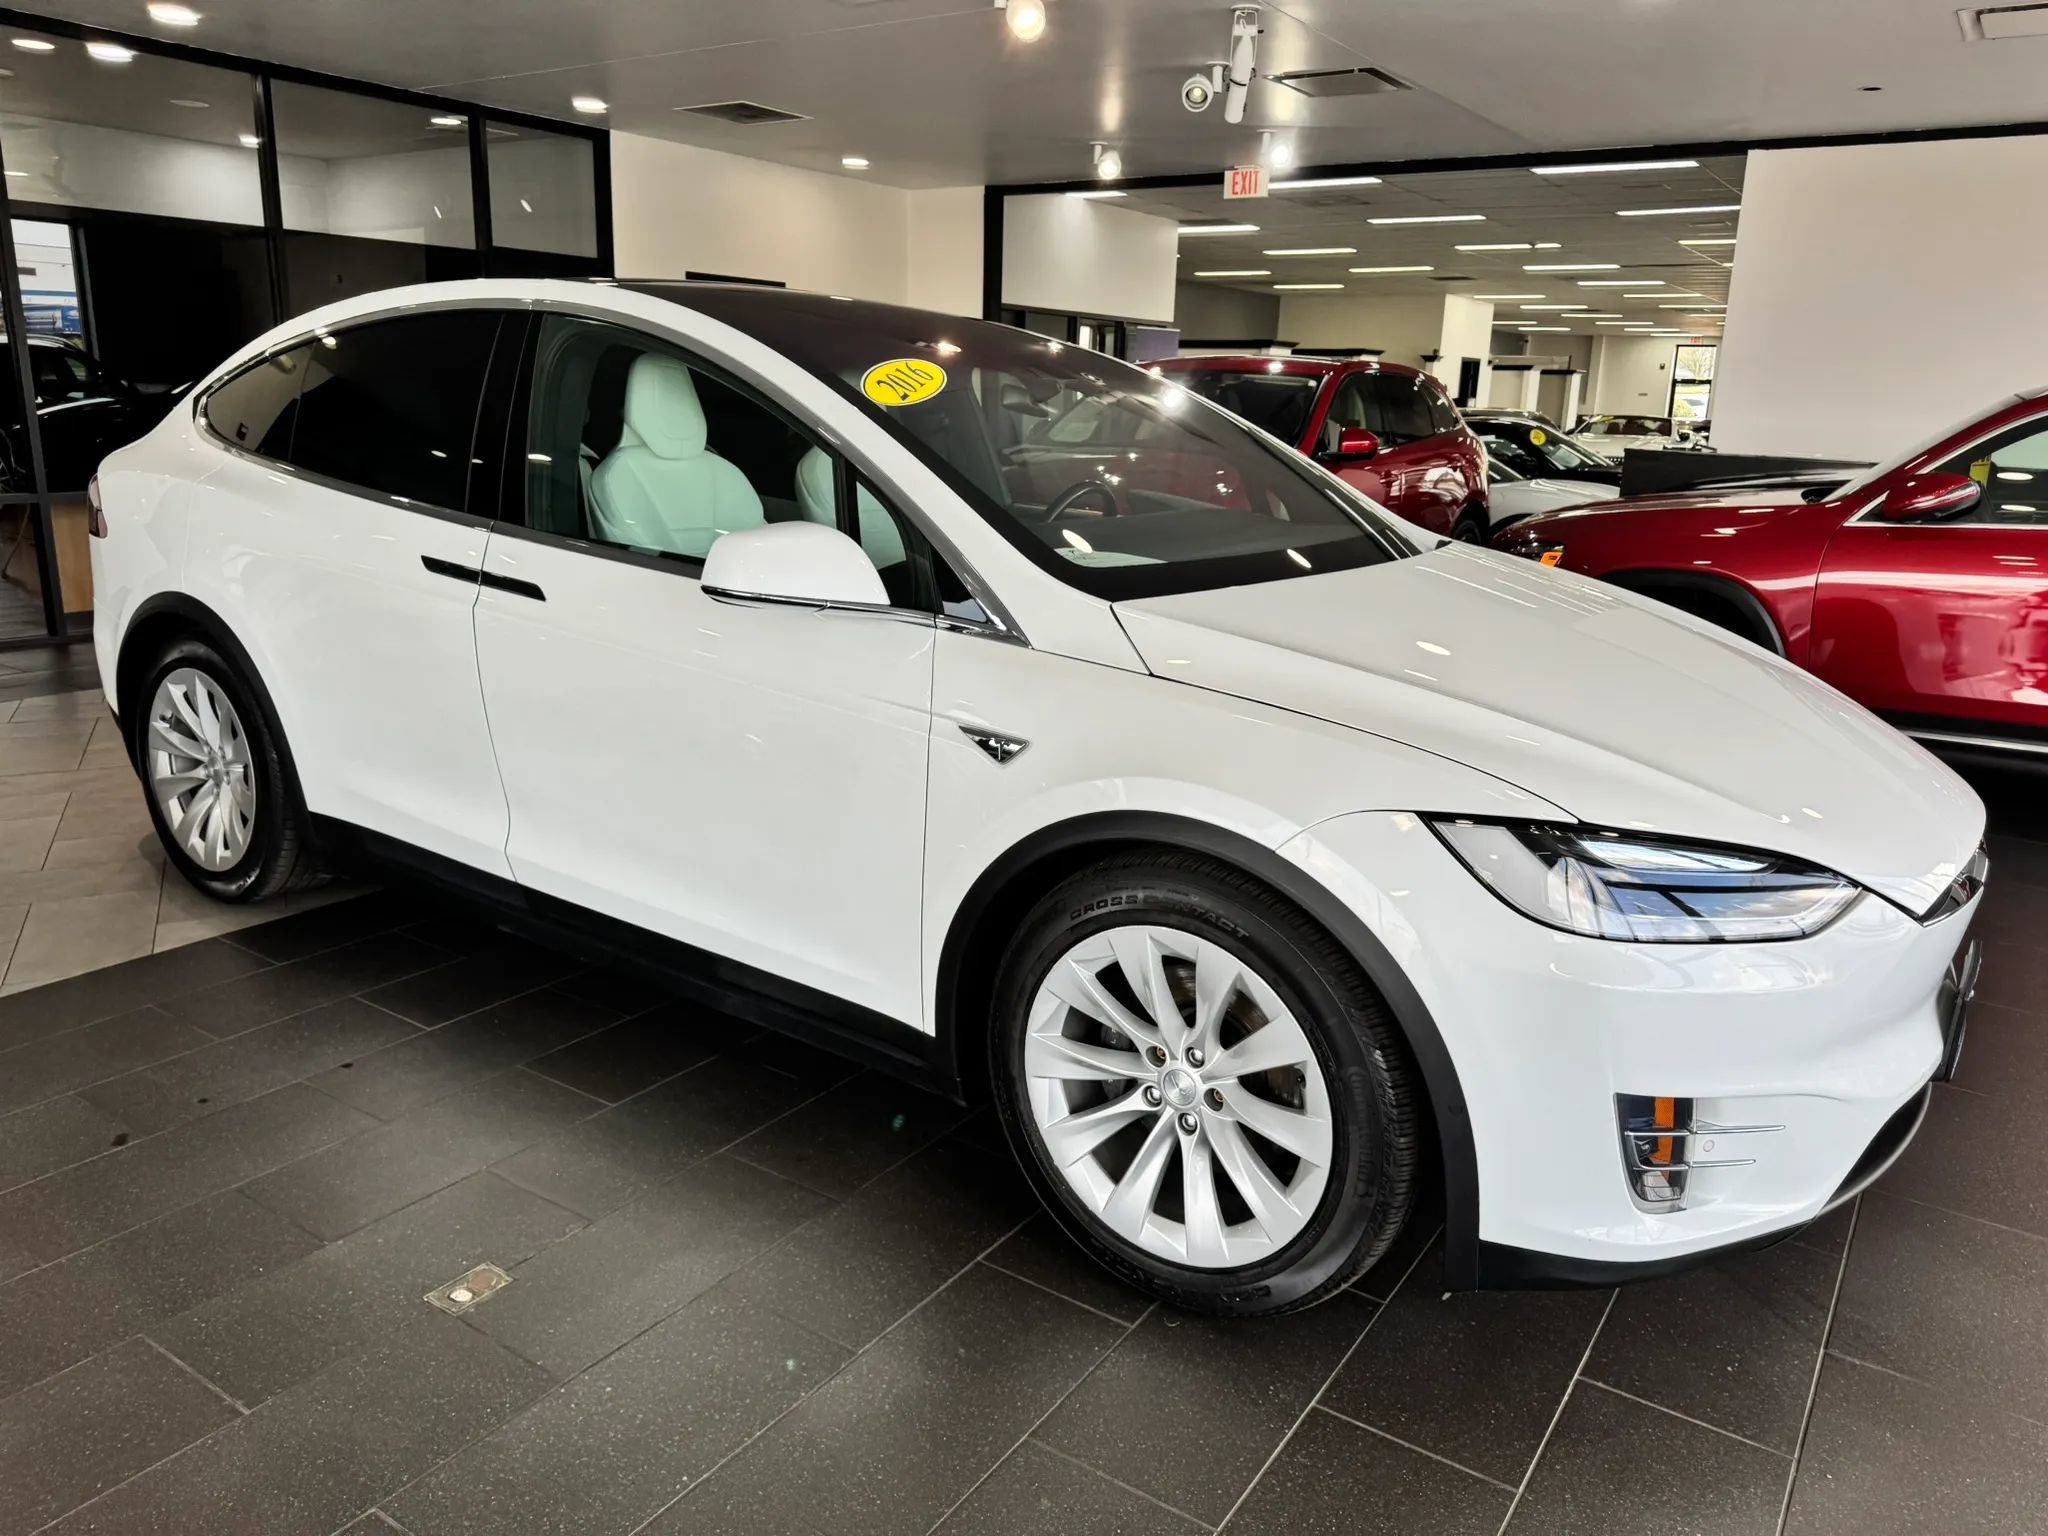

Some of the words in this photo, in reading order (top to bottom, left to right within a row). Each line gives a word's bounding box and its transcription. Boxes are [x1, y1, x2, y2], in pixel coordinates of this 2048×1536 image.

[1232, 170, 1260, 195] EXIT
[876, 362, 934, 401] 2016
[1070, 894, 1139, 921] CROSS
